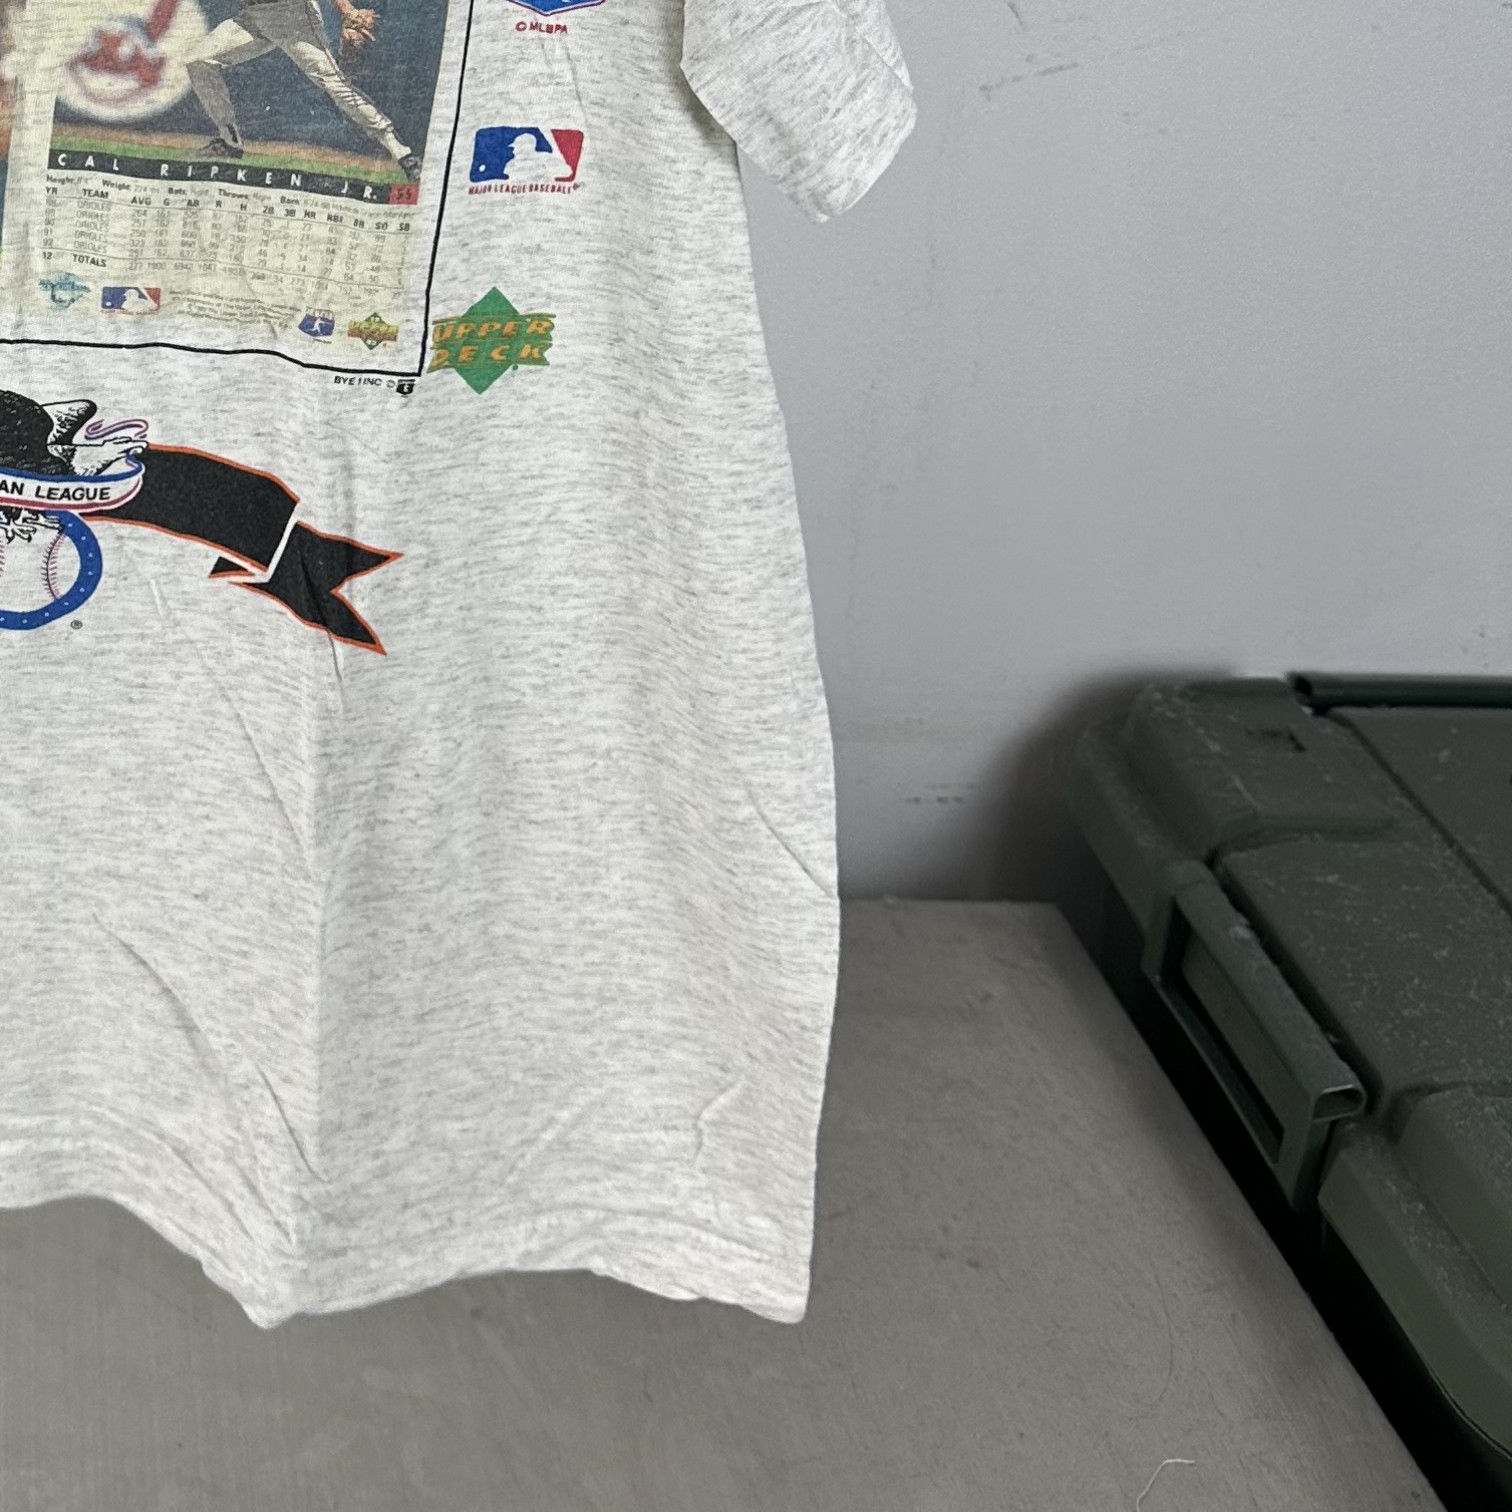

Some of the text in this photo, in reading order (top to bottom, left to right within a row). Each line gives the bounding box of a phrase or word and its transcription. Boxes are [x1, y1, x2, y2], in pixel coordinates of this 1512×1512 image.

[57, 153, 378, 200] CAL RIPKEN JR.
[82, 188, 109, 199] TEAM
[130, 196, 152, 206] AVG
[163, 198, 171, 207] G
[494, 183, 527, 194] LEAGUE
[529, 183, 572, 195] BASEBALL
[42, 251, 107, 268] 12 TOTALS
[432, 318, 553, 342] UPPER
[334, 375, 356, 386] BYE
[34, 485, 112, 502] LEAGUE
